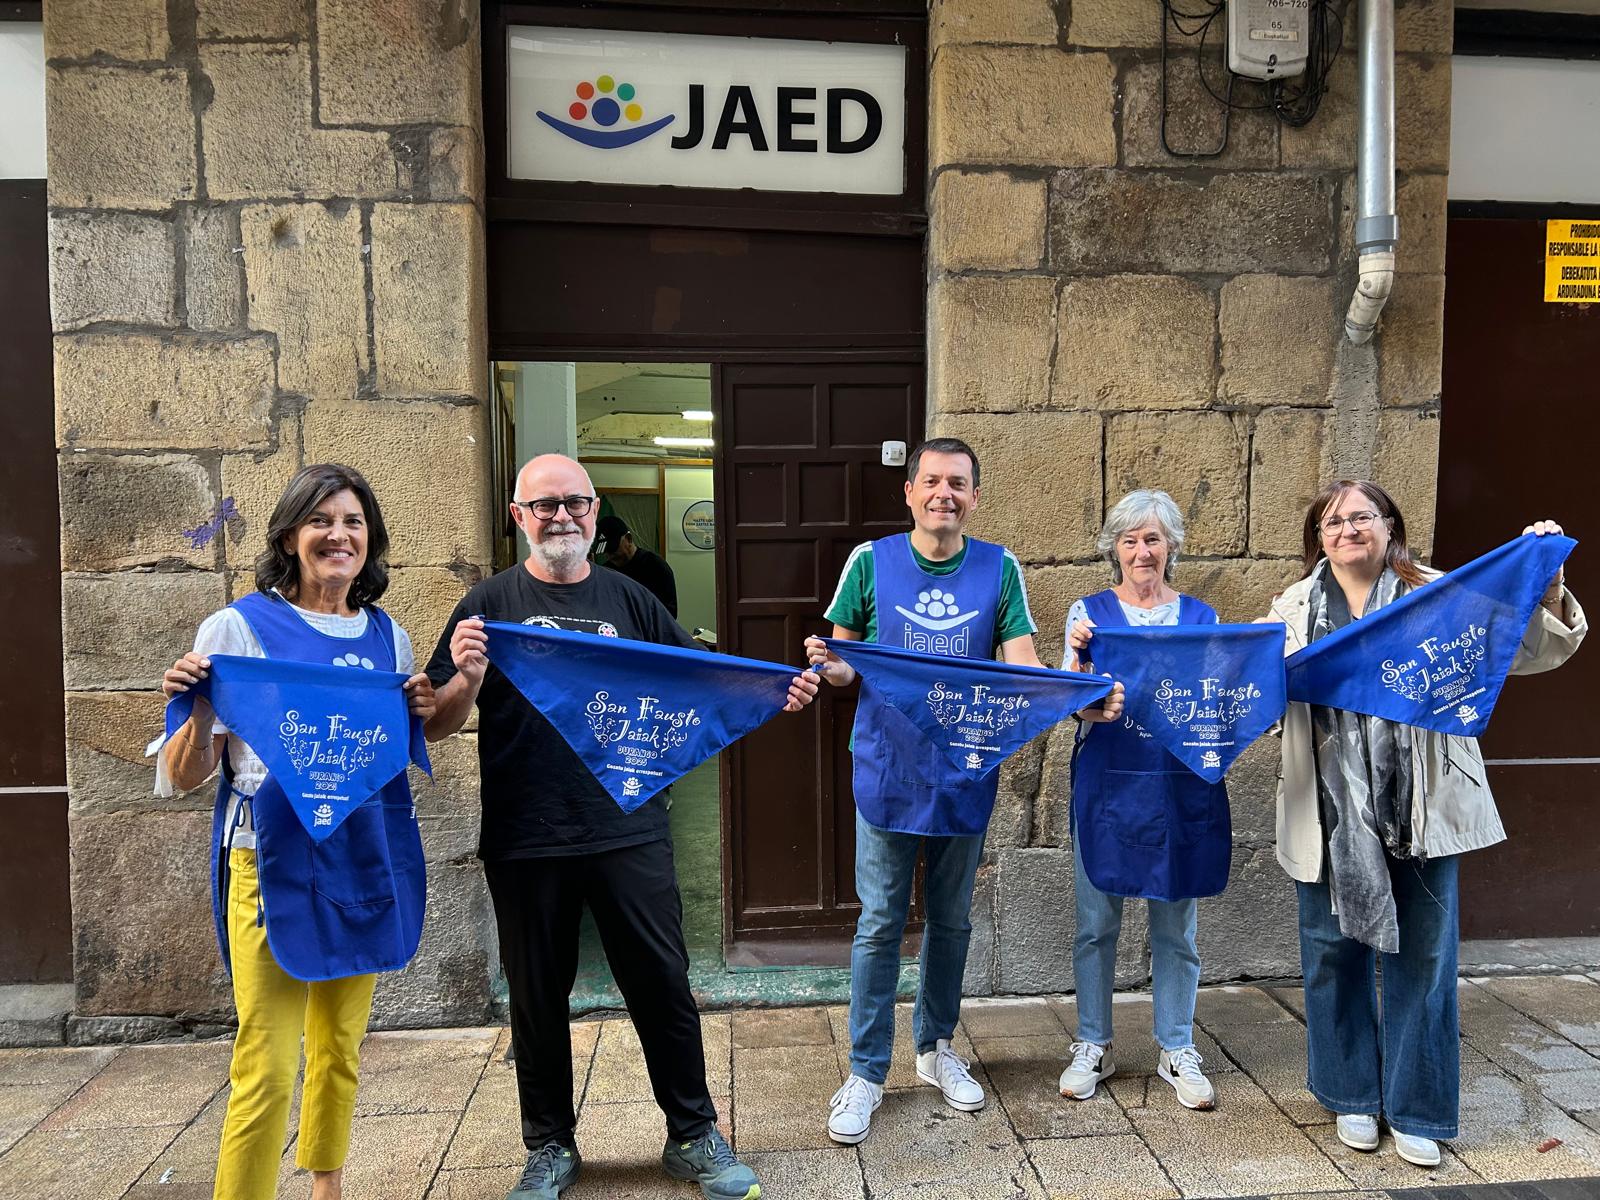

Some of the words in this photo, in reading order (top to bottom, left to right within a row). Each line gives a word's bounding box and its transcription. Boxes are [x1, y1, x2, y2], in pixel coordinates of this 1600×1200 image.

[1271, 21, 1282, 29] 65
[670, 84, 883, 154] JAED
[1548, 241, 1589, 257] RESPONSABLE
[1590, 242, 1599, 257] LA
[1561, 266, 1597, 281] DEBEKATUTA
[1557, 284, 1597, 299] ARDURADUNA
[1381, 658, 1418, 684] San
[1416, 624, 1487, 664] Fausto
[1416, 656, 1467, 694] Jaiak
[927, 682, 963, 702] San
[971, 684, 1030, 711] Fausto
[1155, 678, 1193, 700] San
[1199, 677, 1262, 701] Fausto
[586, 690, 628, 715] San
[637, 696, 701, 728] Fausto
[950, 704, 996, 728] Jaiak
[1180, 701, 1227, 723] Jaiak
[1460, 711, 1480, 726] jaed
[280, 710, 318, 737] San
[326, 714, 388, 747] Fausto
[609, 719, 660, 749] Jaiak
[303, 741, 348, 770] Jaiak
[617, 745, 658, 760] DURANGO
[625, 756, 648, 767] 2025
[966, 760, 982, 769] jaed
[1202, 759, 1221, 769] jaed
[622, 787, 640, 796] jaed
[313, 816, 332, 827] jaed
